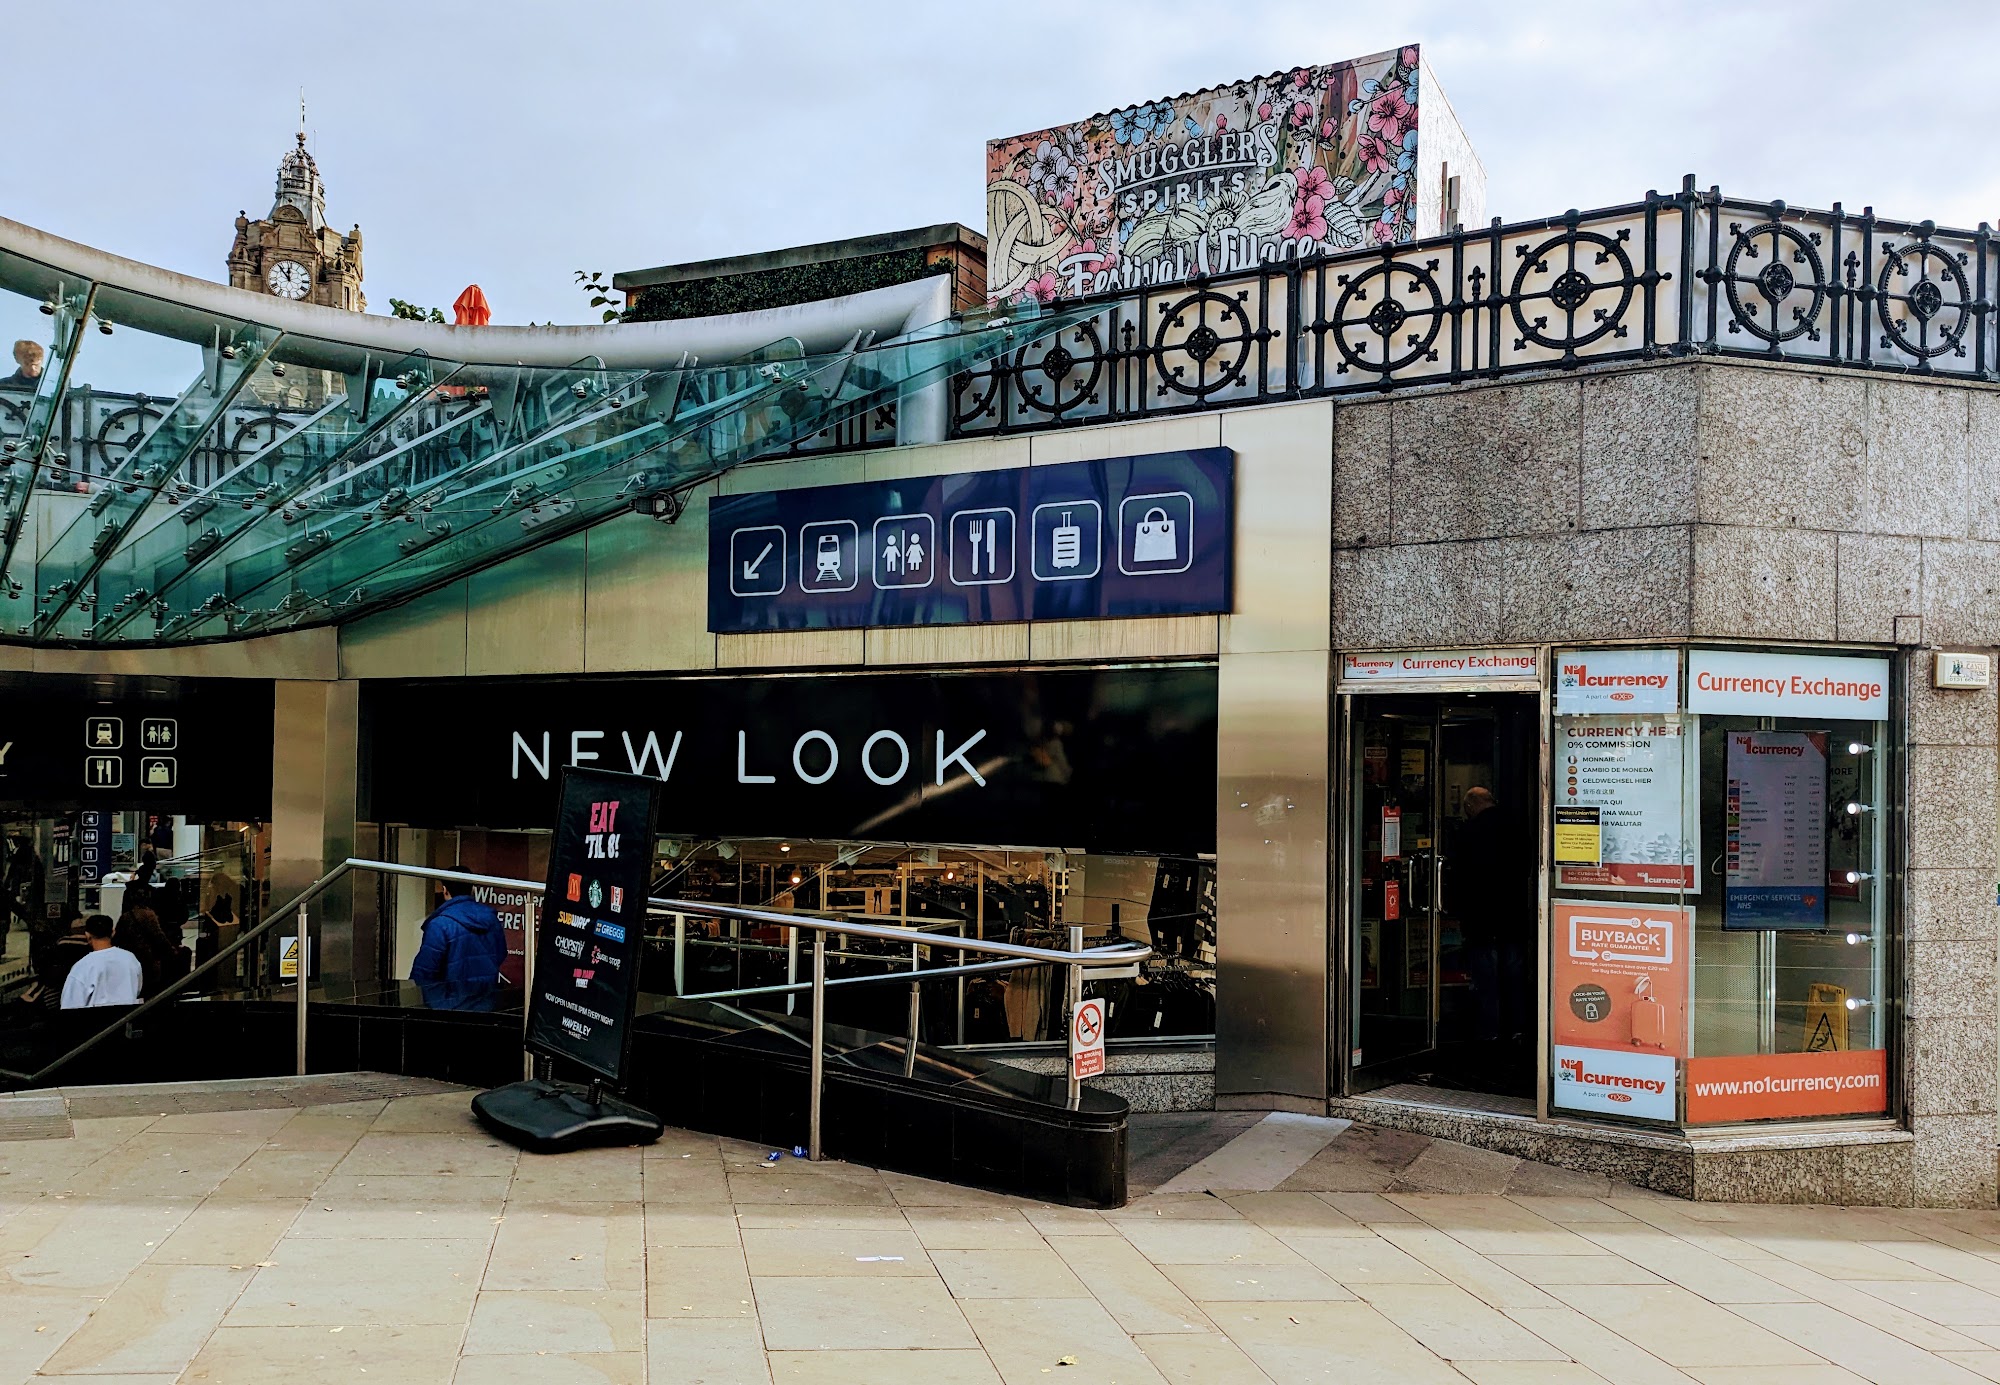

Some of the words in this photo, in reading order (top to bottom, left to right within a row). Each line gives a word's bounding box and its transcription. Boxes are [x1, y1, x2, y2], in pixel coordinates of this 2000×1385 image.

[1096, 123, 1279, 200] SMUGGLERS
[1124, 172, 1246, 213] SPIRITS
[1402, 657, 1466, 670] Currency
[1468, 655, 1536, 669] Exchange
[1697, 671, 1786, 697] Currency
[1791, 675, 1882, 701] Exchange
[1591, 694, 1602, 702] part
[1567, 726, 1643, 738] CURRENCY
[1567, 741, 1584, 749] 0%
[1585, 740, 1651, 749] COMMISSION
[512, 730, 682, 782] NEW
[738, 729, 987, 787] LOOK
[589, 800, 620, 833] EAT
[607, 833, 621, 859] 8!
[601, 924, 624, 940] GREGGS
[1581, 929, 1661, 946] BUYBACK
[1609, 943, 1650, 951] GUARANTEE
[555, 996, 566, 1007] OPEN
[600, 1014, 615, 1027] NIGHT
[1083, 1050, 1102, 1059] smoking
[1081, 1059, 1098, 1067] beyond
[1088, 1066, 1100, 1074] point
[1695, 1072, 1880, 1097] www.no1currency.com
[1588, 1091, 1600, 1099] part
